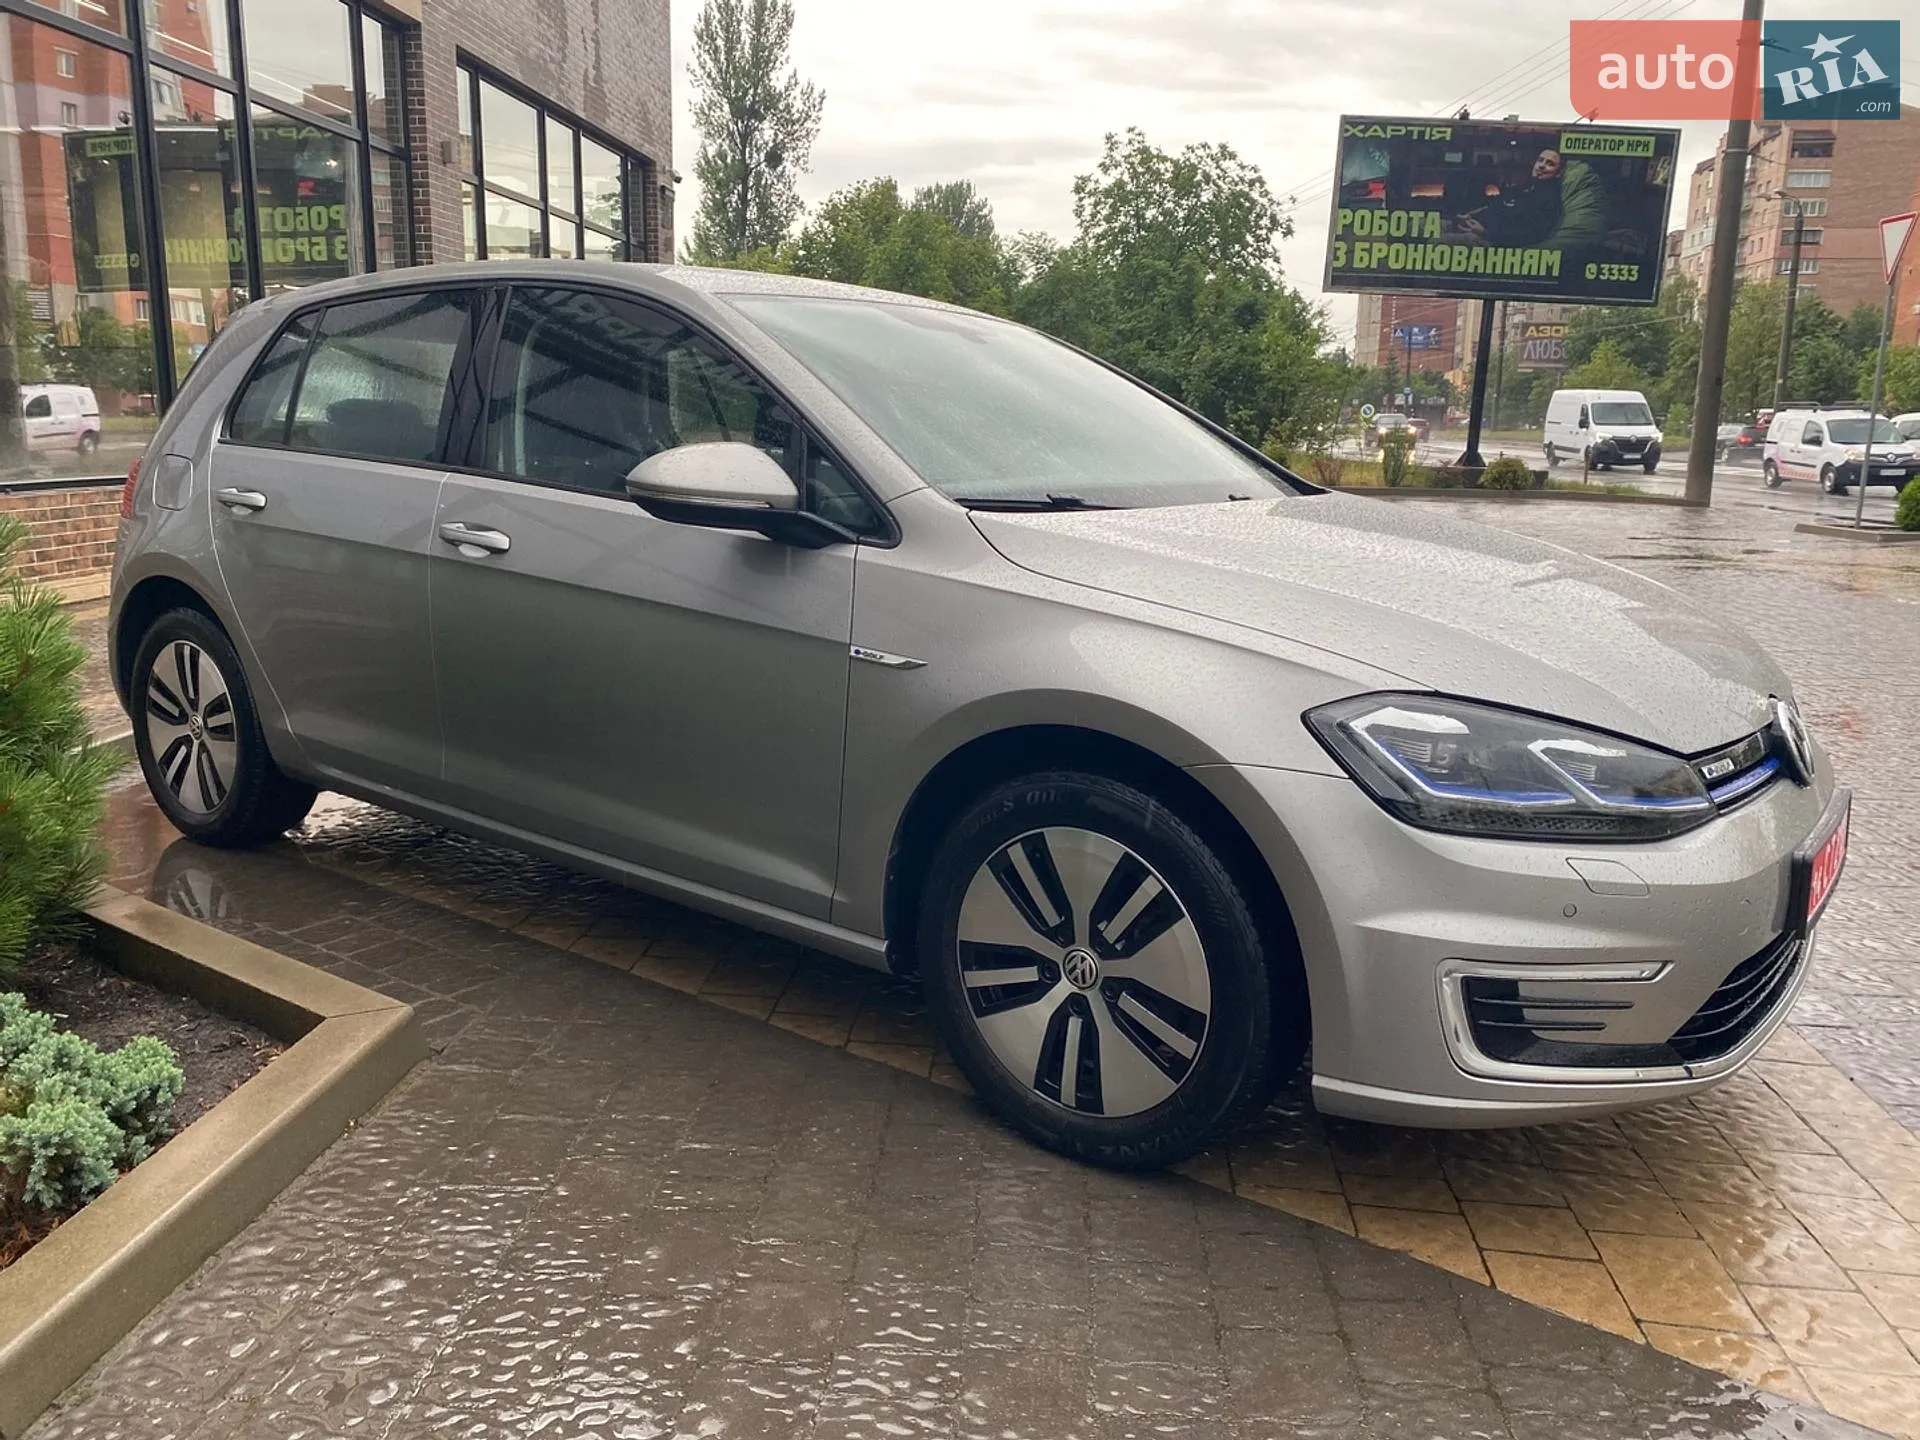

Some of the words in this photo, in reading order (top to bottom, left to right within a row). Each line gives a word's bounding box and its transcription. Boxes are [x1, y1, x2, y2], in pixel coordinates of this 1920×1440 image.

[1343, 124, 1452, 141] ХАРТІЯ
[1565, 136, 1625, 152] ОПЕРАТОР
[1336, 208, 1441, 239] РОБОТА
[1353, 242, 1562, 277] БРОНЮВАННЯМ
[1599, 263, 1640, 282] 3333
